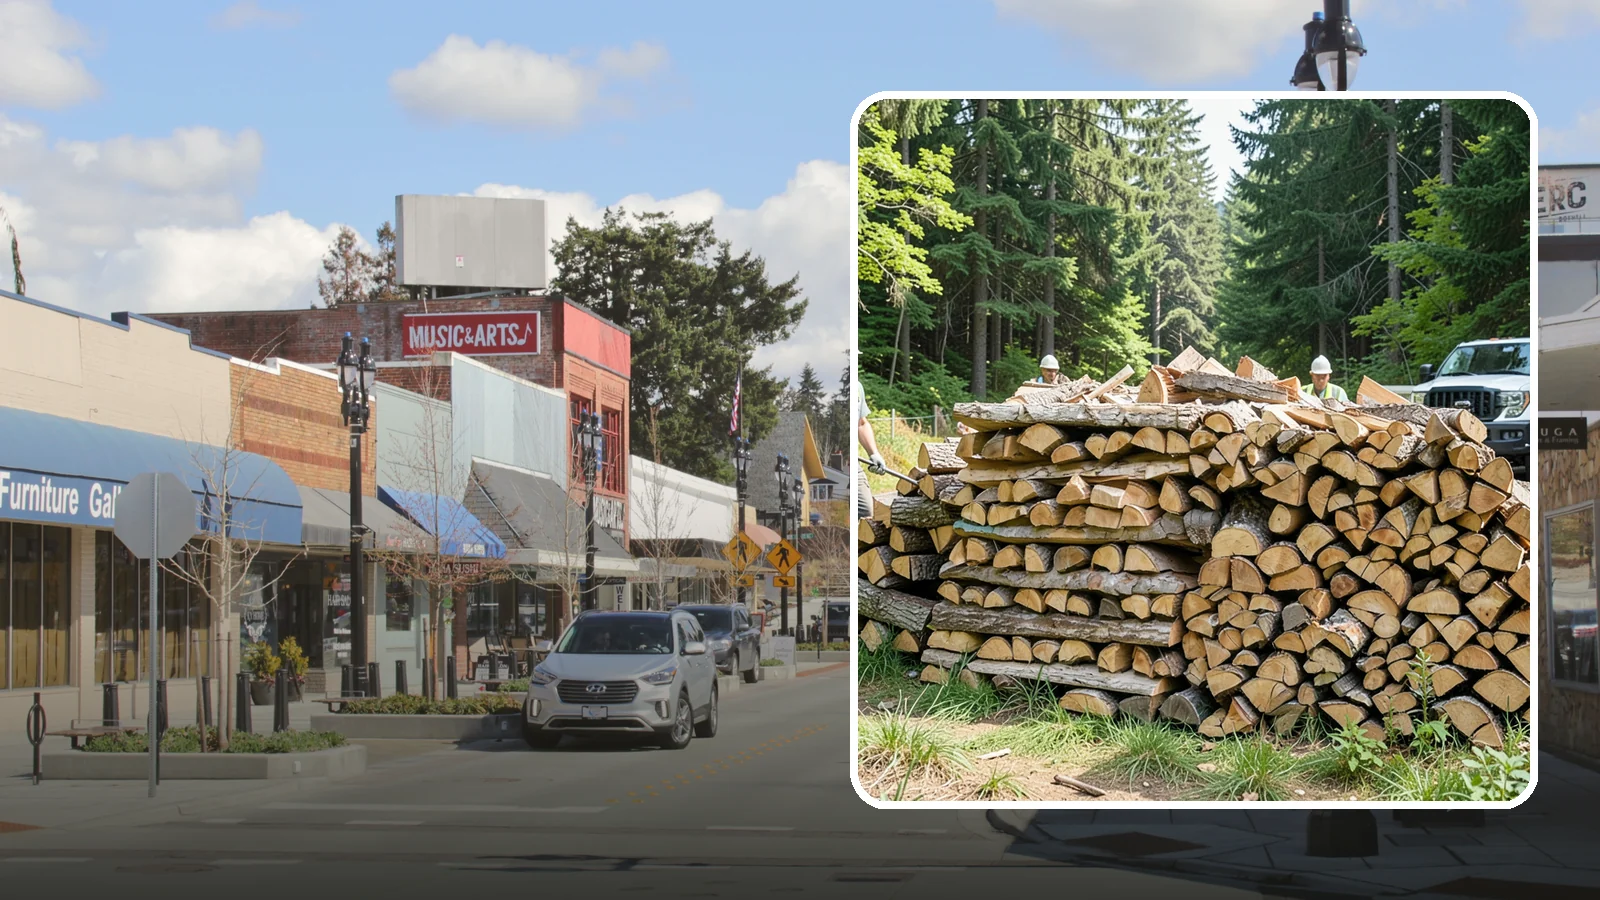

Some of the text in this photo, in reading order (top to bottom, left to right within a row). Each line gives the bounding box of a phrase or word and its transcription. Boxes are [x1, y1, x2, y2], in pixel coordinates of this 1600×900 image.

[1540, 427, 1577, 437] UGA
[0, 471, 122, 519] Furniture Gal
[453, 563, 479, 574] SUSHI
